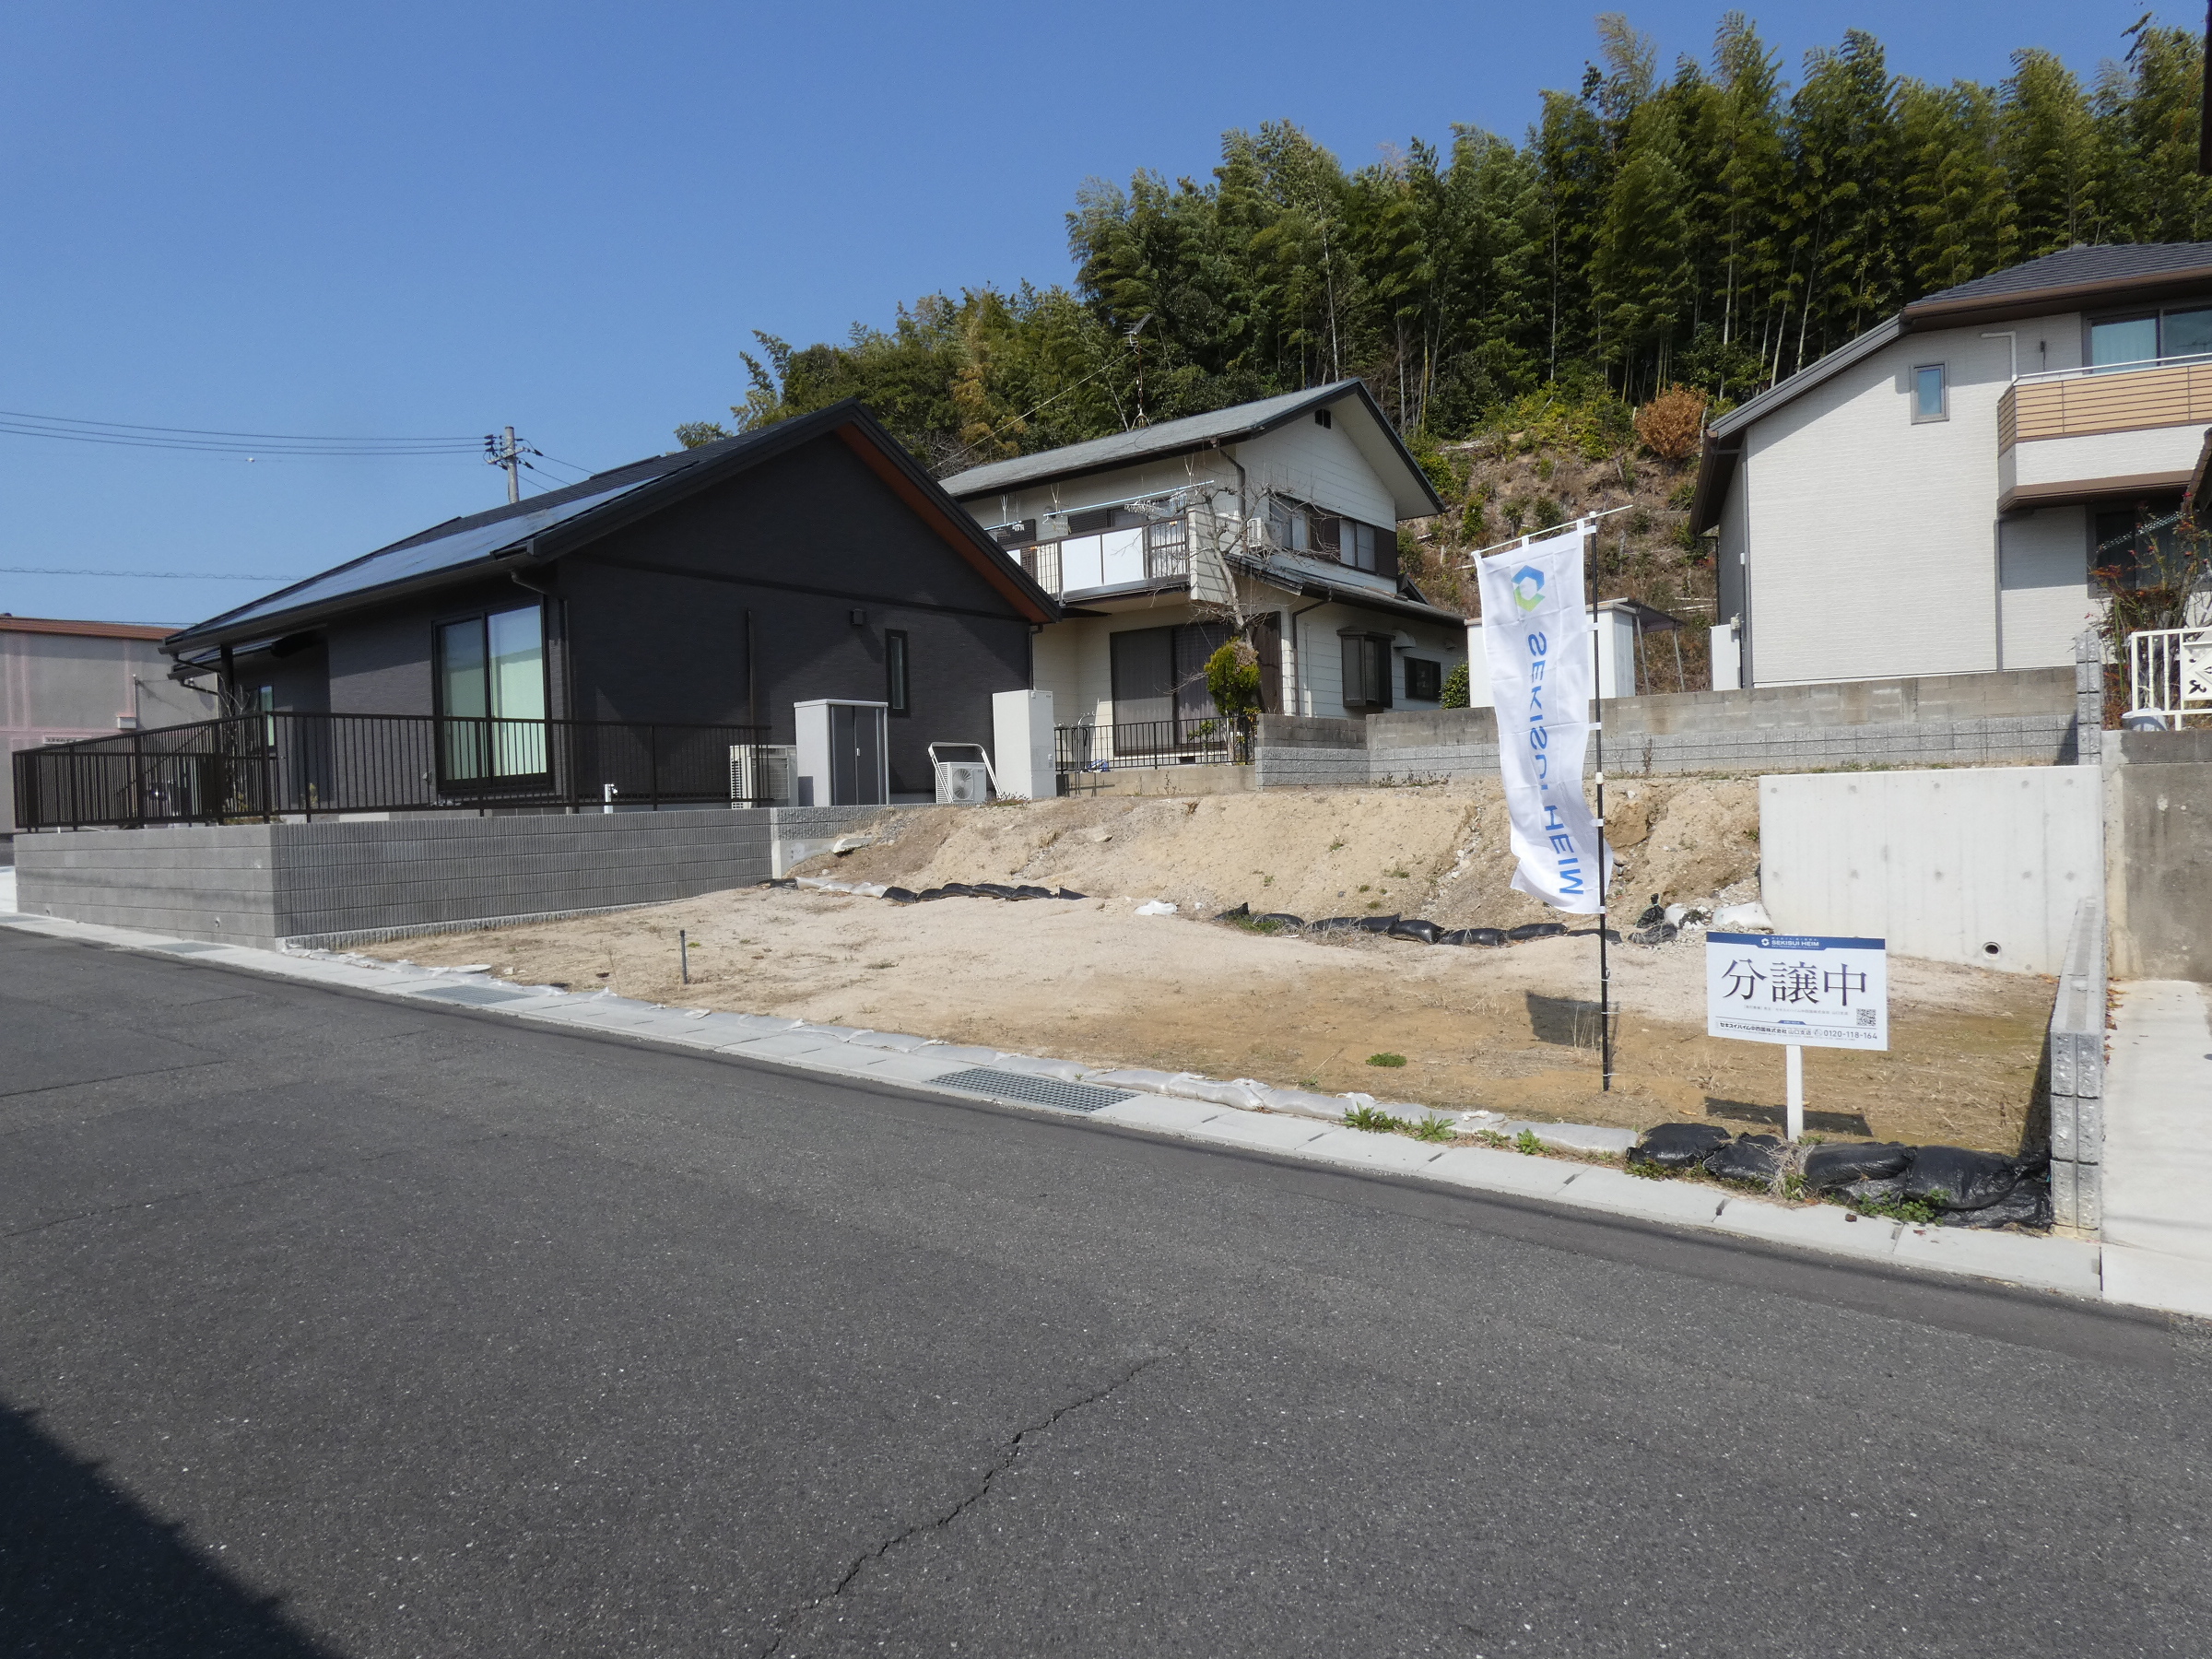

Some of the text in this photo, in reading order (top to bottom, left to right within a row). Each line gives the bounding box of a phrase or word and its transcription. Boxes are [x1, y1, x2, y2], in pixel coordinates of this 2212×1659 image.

[1722, 959, 1867, 1006] 分譲中
[1823, 1030, 1877, 1040] 0120-118-164
